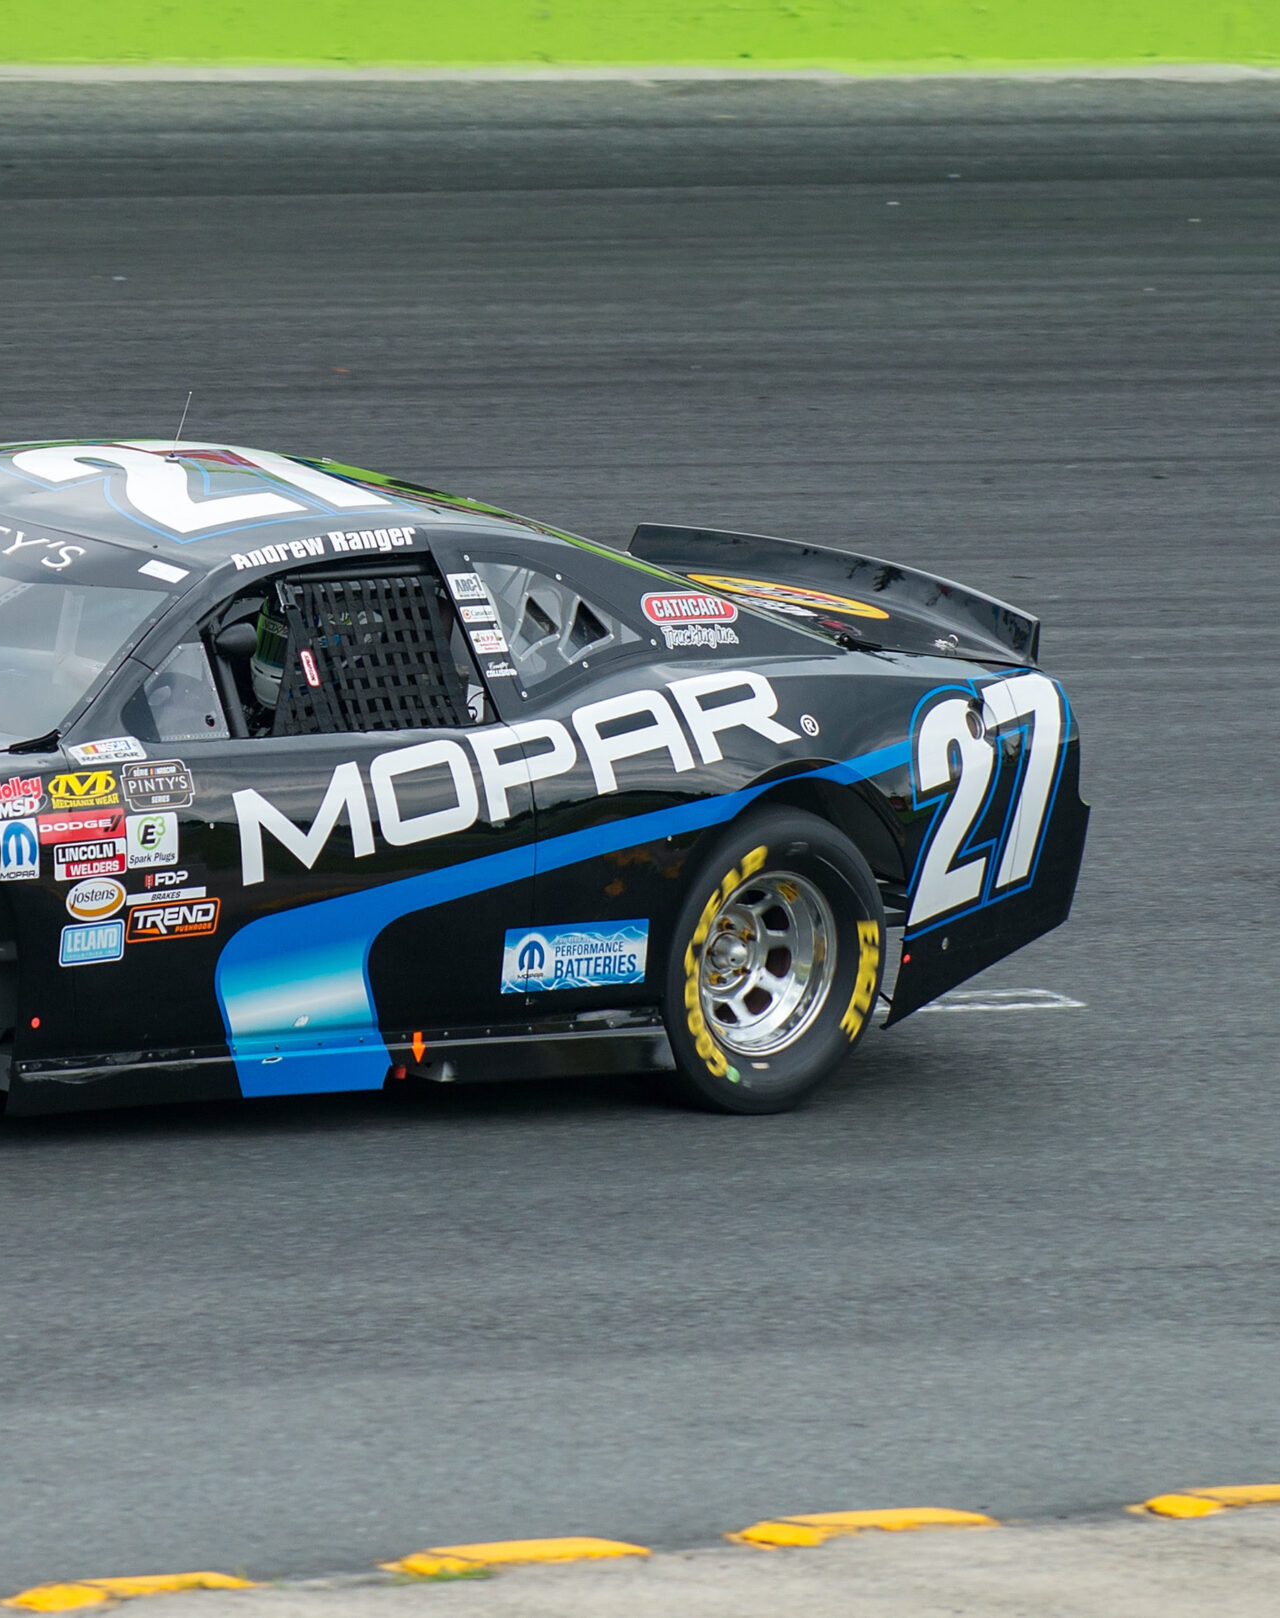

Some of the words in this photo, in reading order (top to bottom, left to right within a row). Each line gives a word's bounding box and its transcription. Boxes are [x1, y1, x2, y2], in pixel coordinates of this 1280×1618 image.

[230, 537, 326, 571] Andrew
[327, 526, 417, 552] Ranger
[651, 597, 725, 618] CATHCART
[661, 624, 717, 649] Trucking
[127, 775, 188, 794] PINTY'S
[231, 670, 802, 886] MOPAR
[51, 795, 95, 809] MECHANIX
[96, 792, 120, 806] WEAR
[907, 672, 1062, 927] 27
[39, 817, 113, 833] DODGE
[58, 842, 114, 863] LINCOLN
[129, 854, 152, 867] Spark
[153, 852, 176, 865] Plugs
[0, 870, 36, 879] MOPAR
[70, 860, 120, 877] WELDERS
[154, 870, 189, 887] FDP
[70, 888, 116, 910] jostens
[151, 891, 182, 901] BRAKES
[133, 903, 216, 934] TREND
[66, 927, 118, 953] LELAND
[555, 941, 624, 957] PERFORMANCE
[554, 953, 637, 979] BATTERIES
